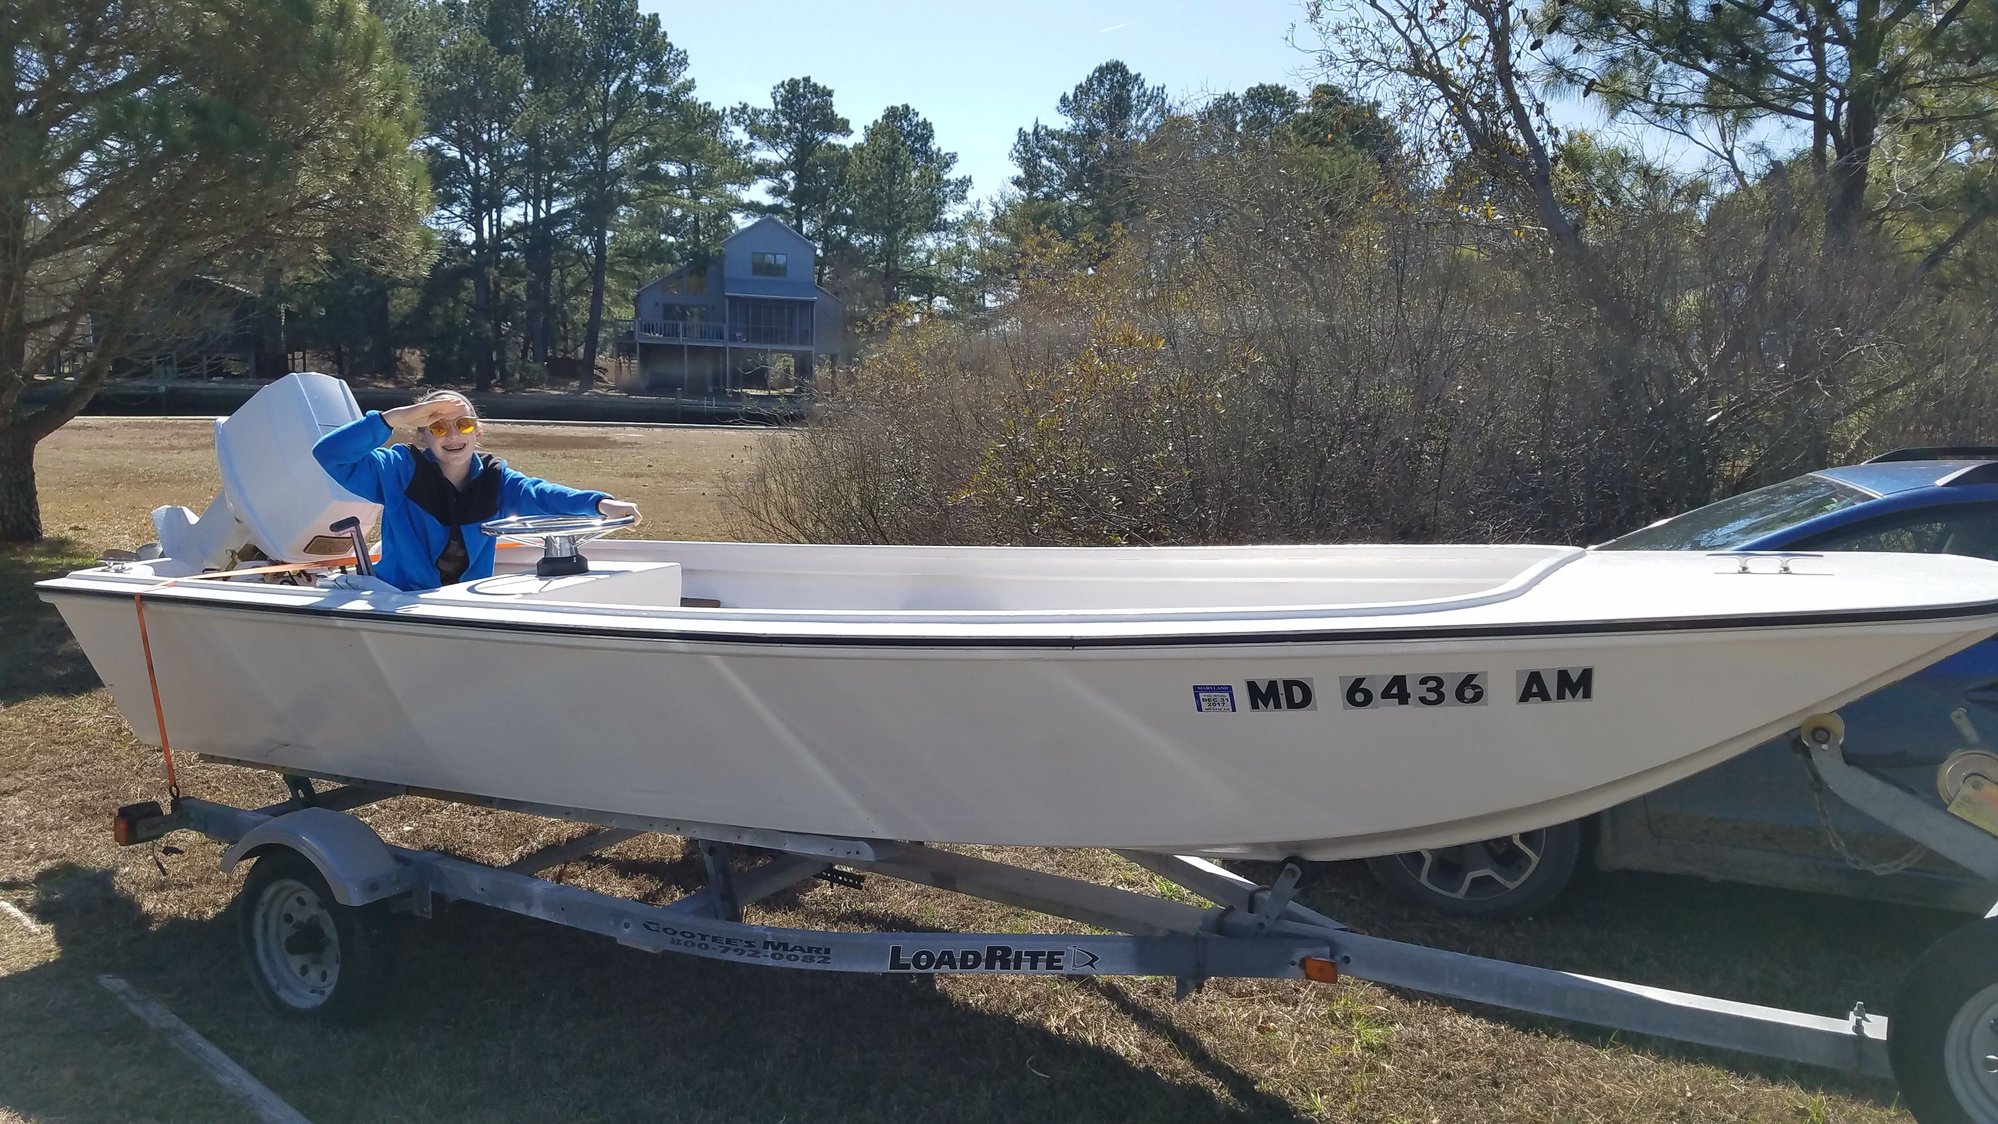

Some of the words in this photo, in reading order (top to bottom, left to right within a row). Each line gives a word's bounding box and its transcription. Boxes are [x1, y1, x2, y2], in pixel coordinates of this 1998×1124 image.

[1246, 678, 1313, 710] MD
[1345, 673, 1485, 708] 6436
[1517, 667, 1594, 703] AM
[670, 937, 832, 964] 800-792-0082
